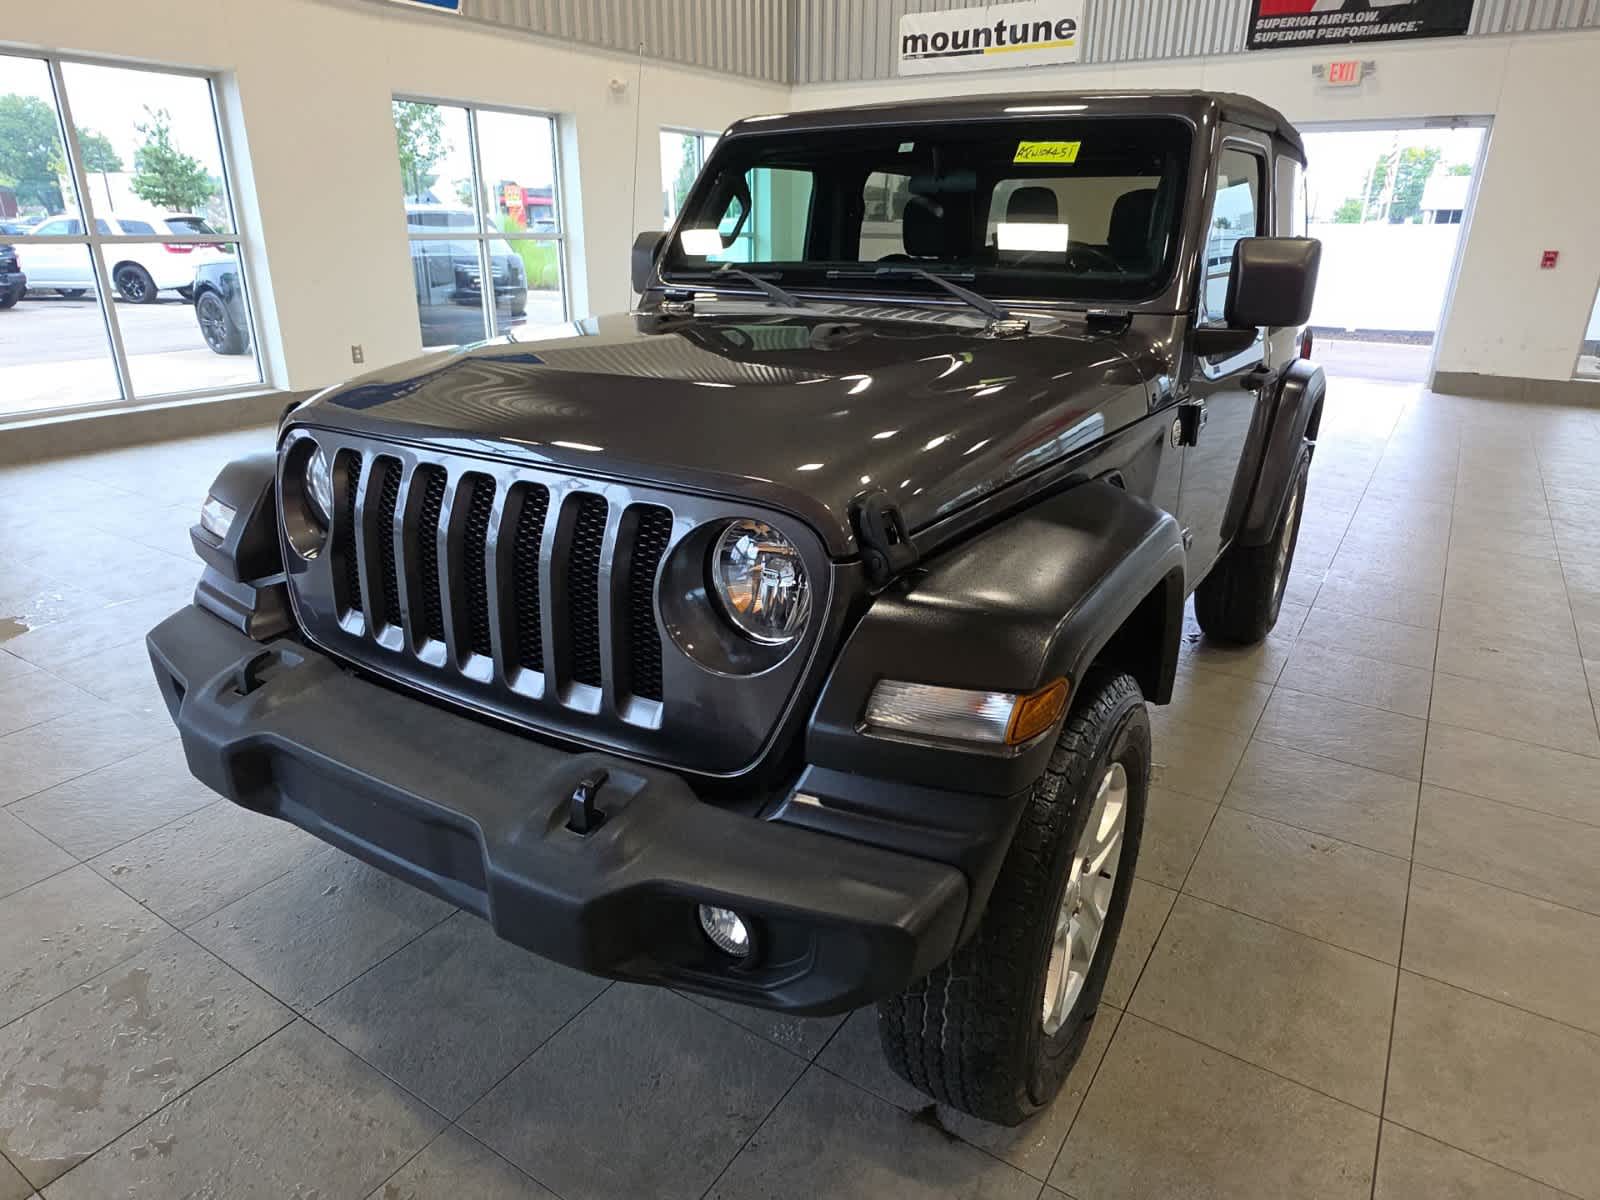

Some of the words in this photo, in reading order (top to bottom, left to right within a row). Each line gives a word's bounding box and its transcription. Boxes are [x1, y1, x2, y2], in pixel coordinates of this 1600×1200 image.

[1256, 15, 1319, 29] SUPERIOR
[1319, 11, 1380, 25] AIRFLOW.
[902, 18, 1077, 54] mountune
[1253, 30, 1316, 43] SUPERIOR
[1329, 63, 1357, 81] EXIT
